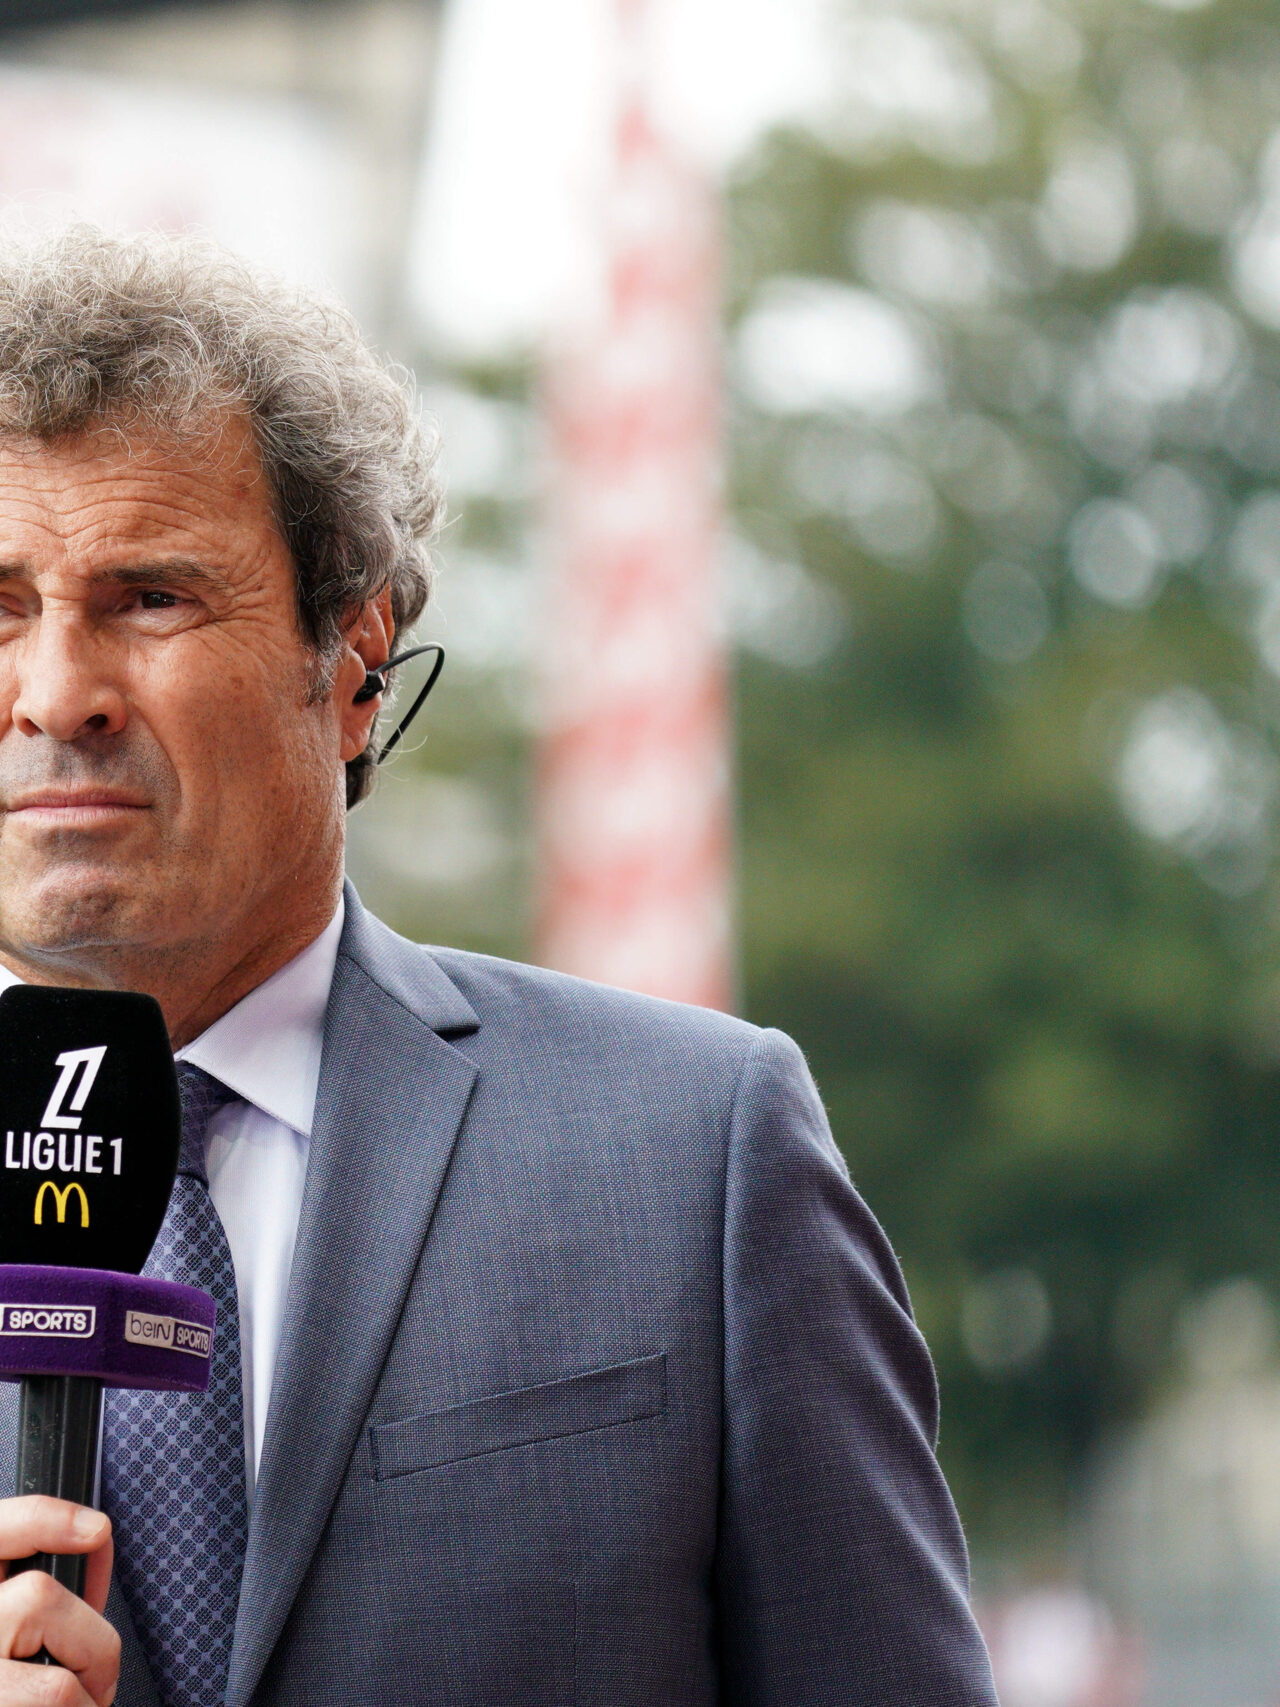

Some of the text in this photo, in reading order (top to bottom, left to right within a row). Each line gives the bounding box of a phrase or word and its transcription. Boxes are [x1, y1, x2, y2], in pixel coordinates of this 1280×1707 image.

[5, 1131, 123, 1176] LIGUE 1
[9, 1310, 88, 1332] SPORTS
[176, 1326, 210, 1353] SPORTS
